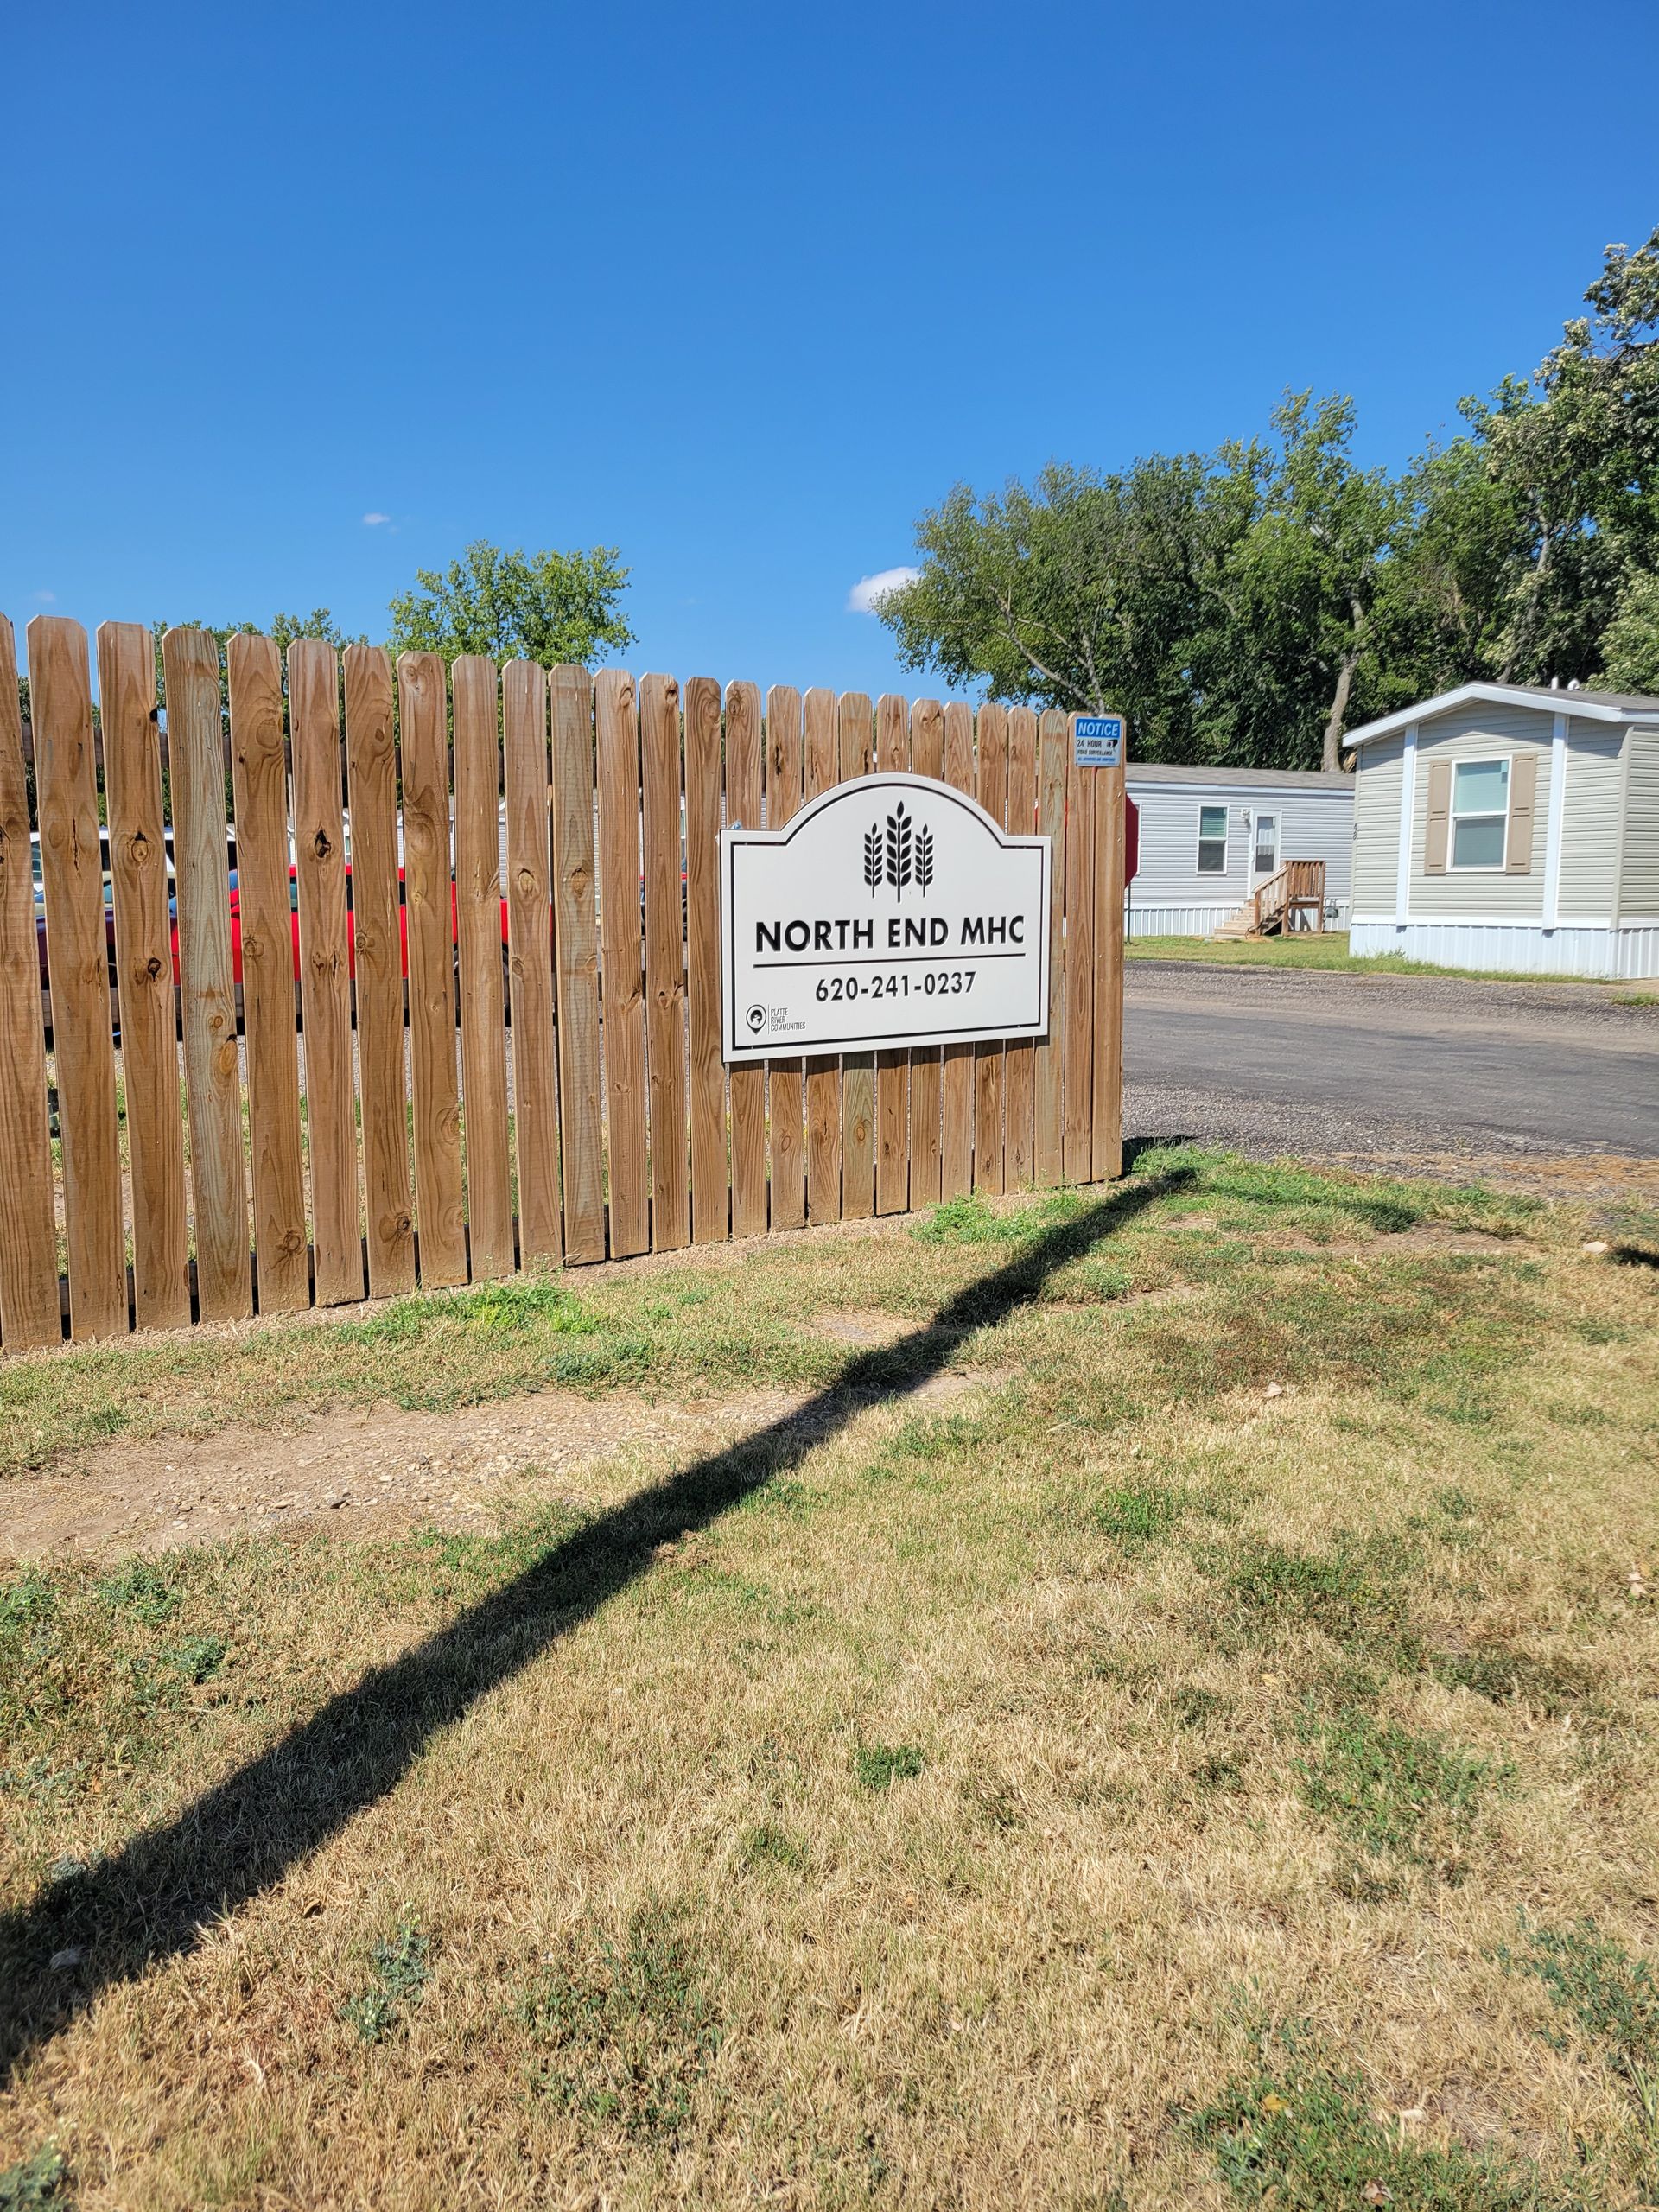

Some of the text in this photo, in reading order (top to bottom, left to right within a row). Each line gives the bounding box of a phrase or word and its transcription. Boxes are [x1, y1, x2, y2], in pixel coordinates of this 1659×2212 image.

[1077, 722, 1119, 736] NOTICE
[1087, 740, 1102, 748] HOUR
[755, 915, 1025, 953] NORTH END MHC
[815, 971, 976, 1002] 620-241-0237
[770, 1007, 788, 1017] PLATTE
[770, 1015, 786, 1025] RIVER
[770, 1021, 806, 1032] COMMUNITIES
